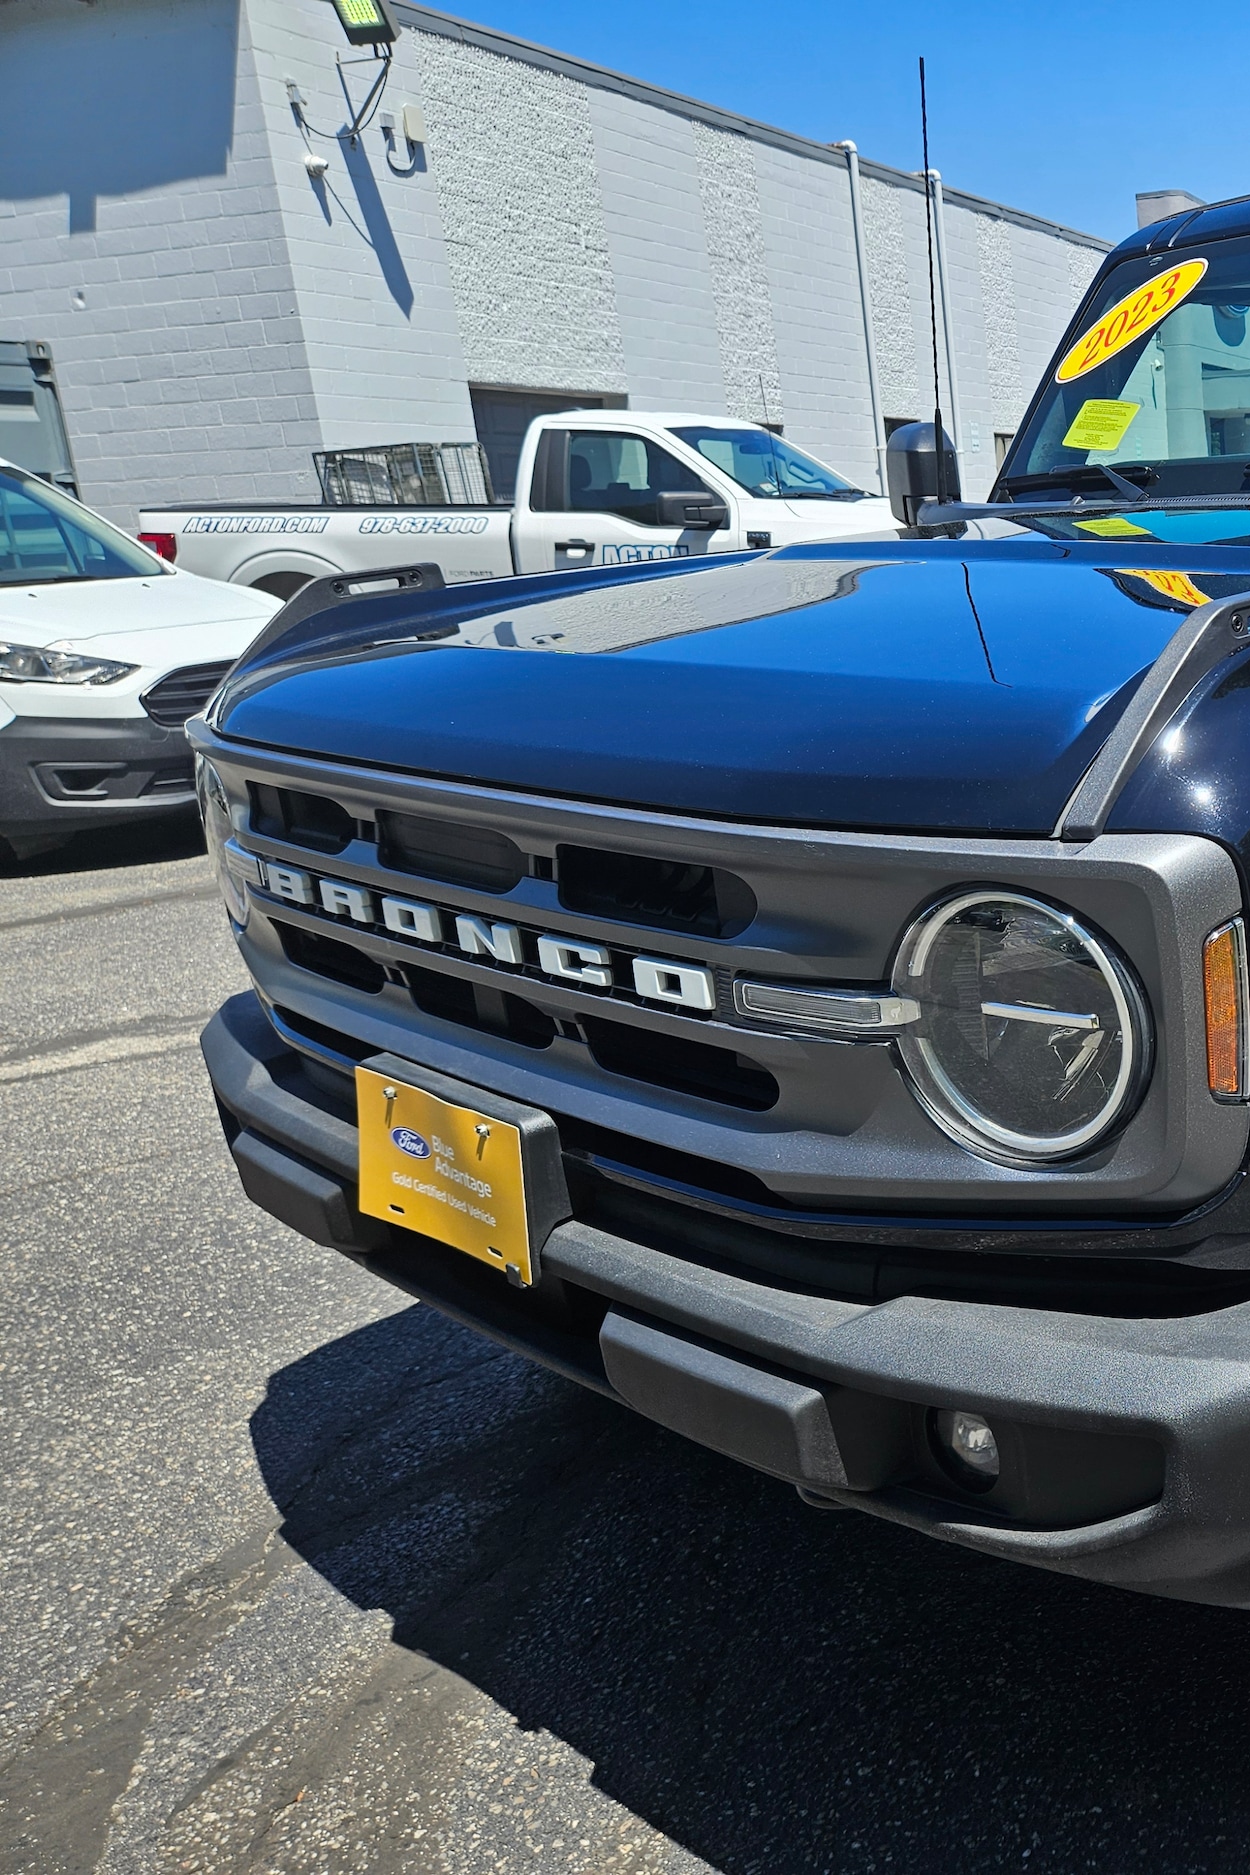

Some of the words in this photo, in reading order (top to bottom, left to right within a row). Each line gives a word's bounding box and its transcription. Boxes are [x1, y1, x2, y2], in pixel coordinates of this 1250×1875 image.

[1078, 272, 1181, 371] 2023
[182, 516, 330, 534] ACTONFORD.COM
[358, 516, 489, 534] 978-637-2000
[268, 863, 717, 1010] BRONCO
[397, 1130, 425, 1156] Ford
[431, 1135, 455, 1161] Blue
[435, 1157, 492, 1198] Advantage
[391, 1171, 413, 1189] Gold
[412, 1178, 447, 1203] Certified
[447, 1193, 467, 1213] Used
[466, 1202, 497, 1228] Vehicle
